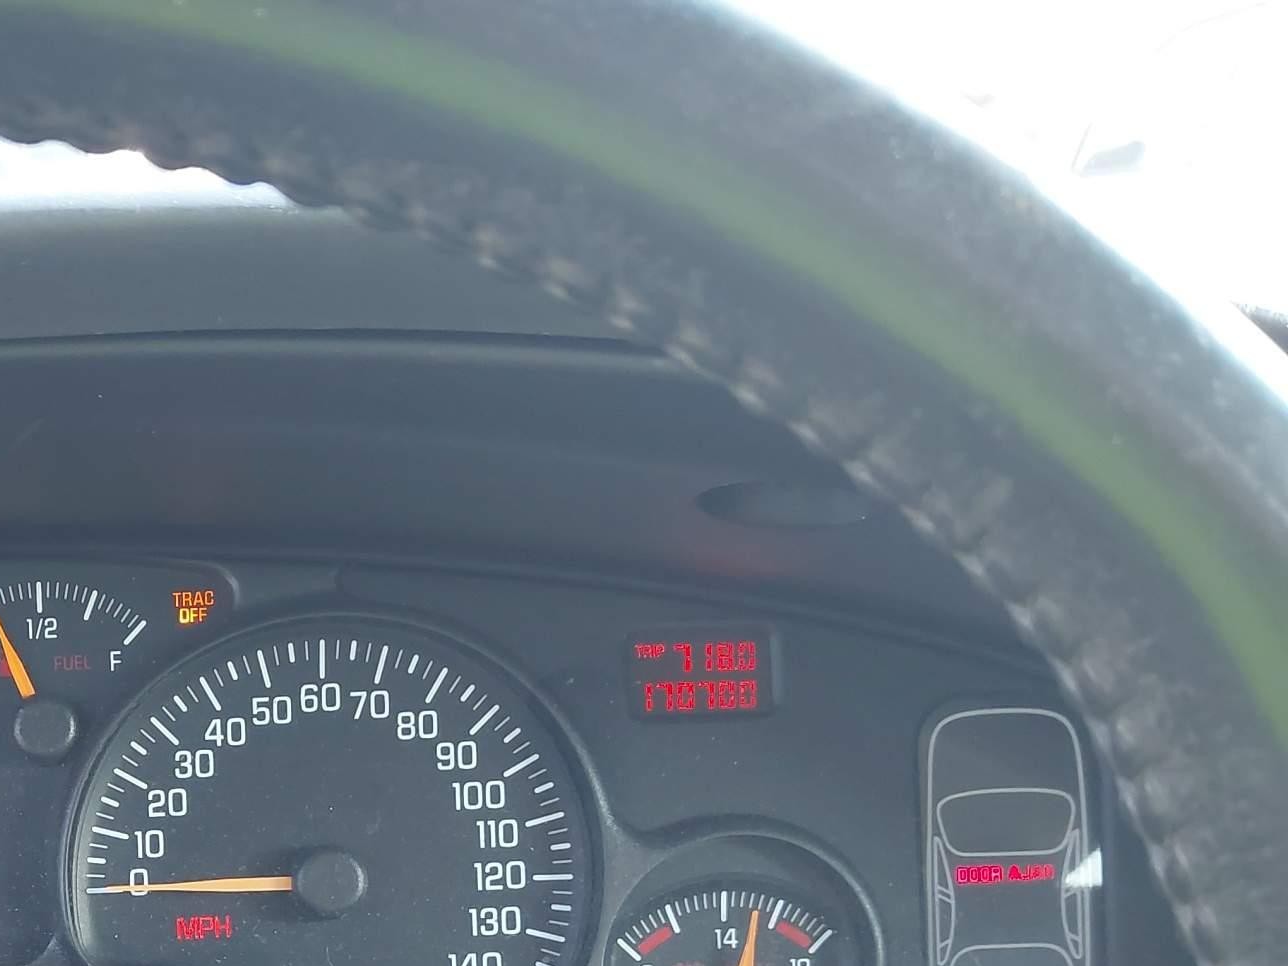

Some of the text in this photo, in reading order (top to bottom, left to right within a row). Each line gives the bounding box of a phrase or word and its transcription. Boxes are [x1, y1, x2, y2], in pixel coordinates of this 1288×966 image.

[172, 591, 214, 608] TRAC
[27, 618, 57, 640] 1/2
[178, 607, 208, 624] OFF
[54, 656, 92, 672] FUEL
[110, 651, 122, 672] F
[635, 643, 665, 659] TRIP
[300, 683, 341, 712] 60
[350, 691, 390, 720] 70
[644, 680, 757, 712] 170700
[251, 696, 292, 725] 50
[204, 718, 246, 746] 40
[396, 710, 438, 740] 80
[174, 749, 214, 778] 30
[436, 741, 478, 770] 90
[147, 789, 187, 817] 20
[452, 780, 506, 811] 100
[134, 830, 165, 859] 10
[476, 819, 518, 848] 110
[129, 868, 148, 896] 0
[474, 861, 526, 891] 120
[956, 865, 1003, 885] DOOR
[176, 915, 232, 940] MPH
[468, 906, 521, 936] 130
[715, 928, 738, 949] 14
